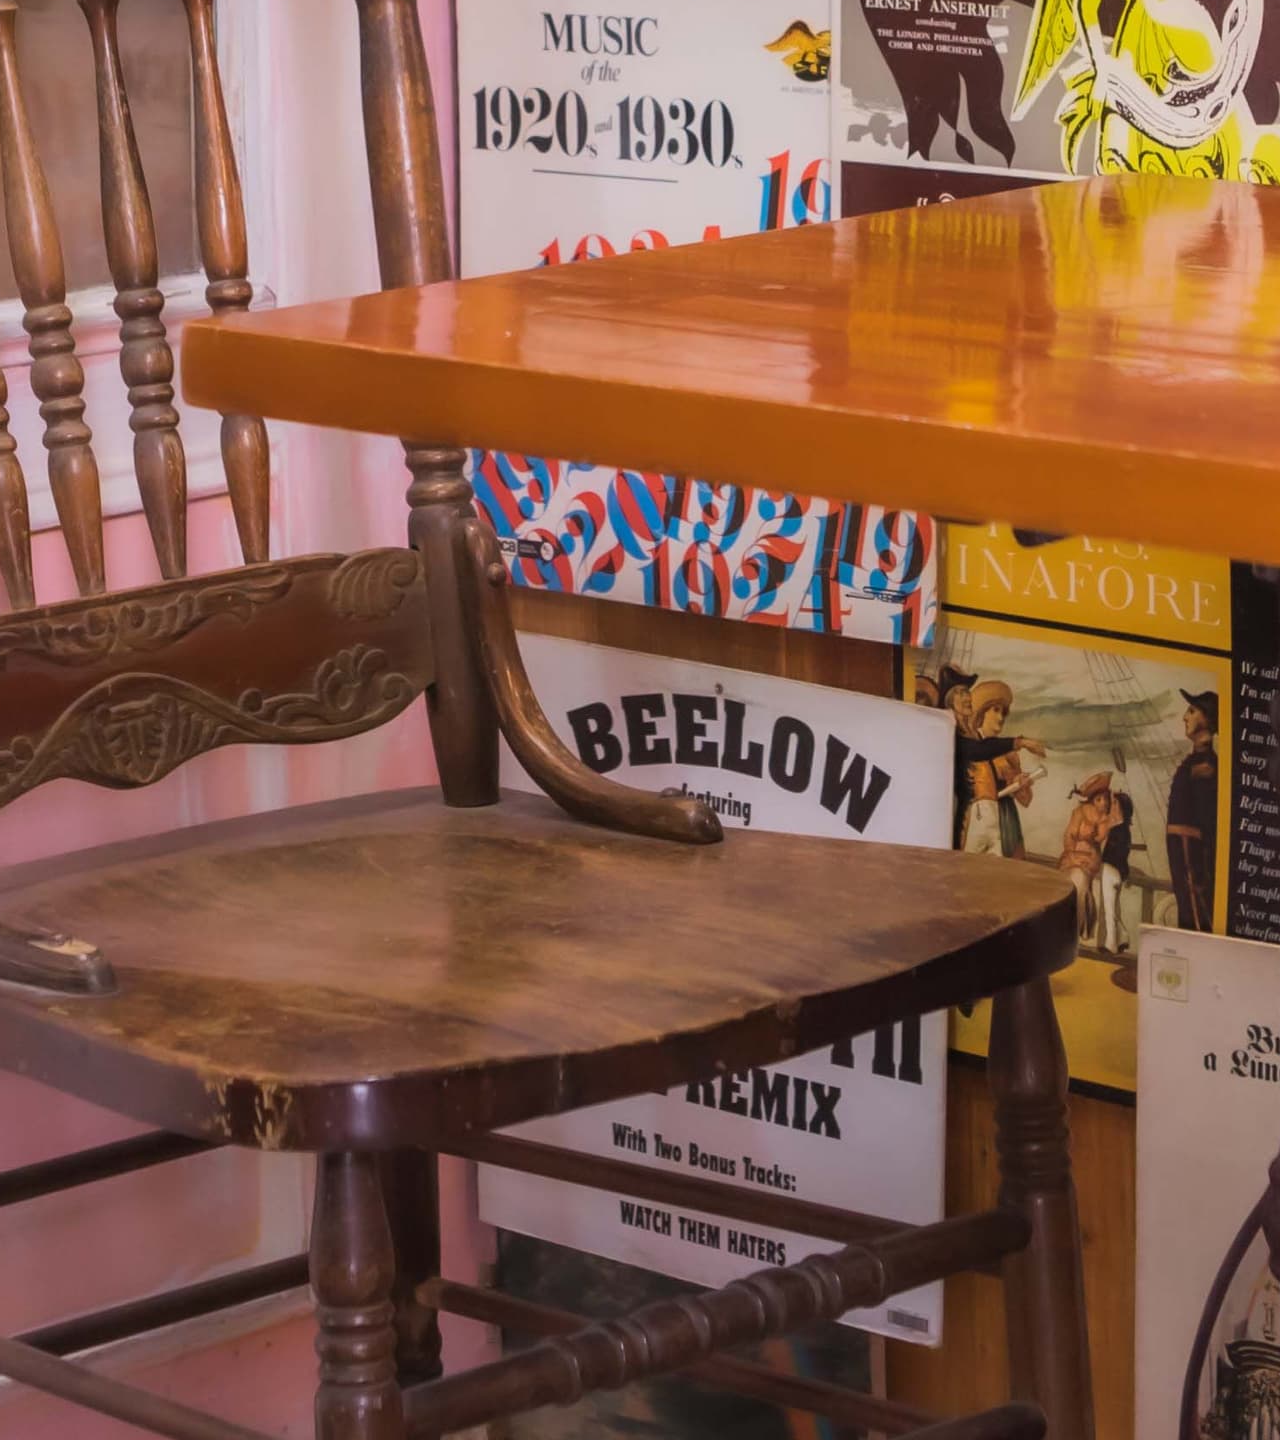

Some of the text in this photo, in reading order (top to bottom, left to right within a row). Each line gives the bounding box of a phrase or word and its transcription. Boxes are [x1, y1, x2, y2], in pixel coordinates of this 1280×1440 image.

[540, 11, 659, 58] MUSIC
[878, 28, 931, 41] THE LONDON
[915, 17, 957, 30] conducting
[888, 40, 983, 57] CHOIR AND ORCHESTRA
[580, 60, 621, 85] of the
[958, 543, 1222, 627] INAFORE
[566, 693, 892, 834] BEELOW
[1241, 773, 1270, 792] When
[612, 1122, 797, 1192] With Two Bonus Tracks:
[619, 1200, 786, 1267] WATCH THEM HATERS
